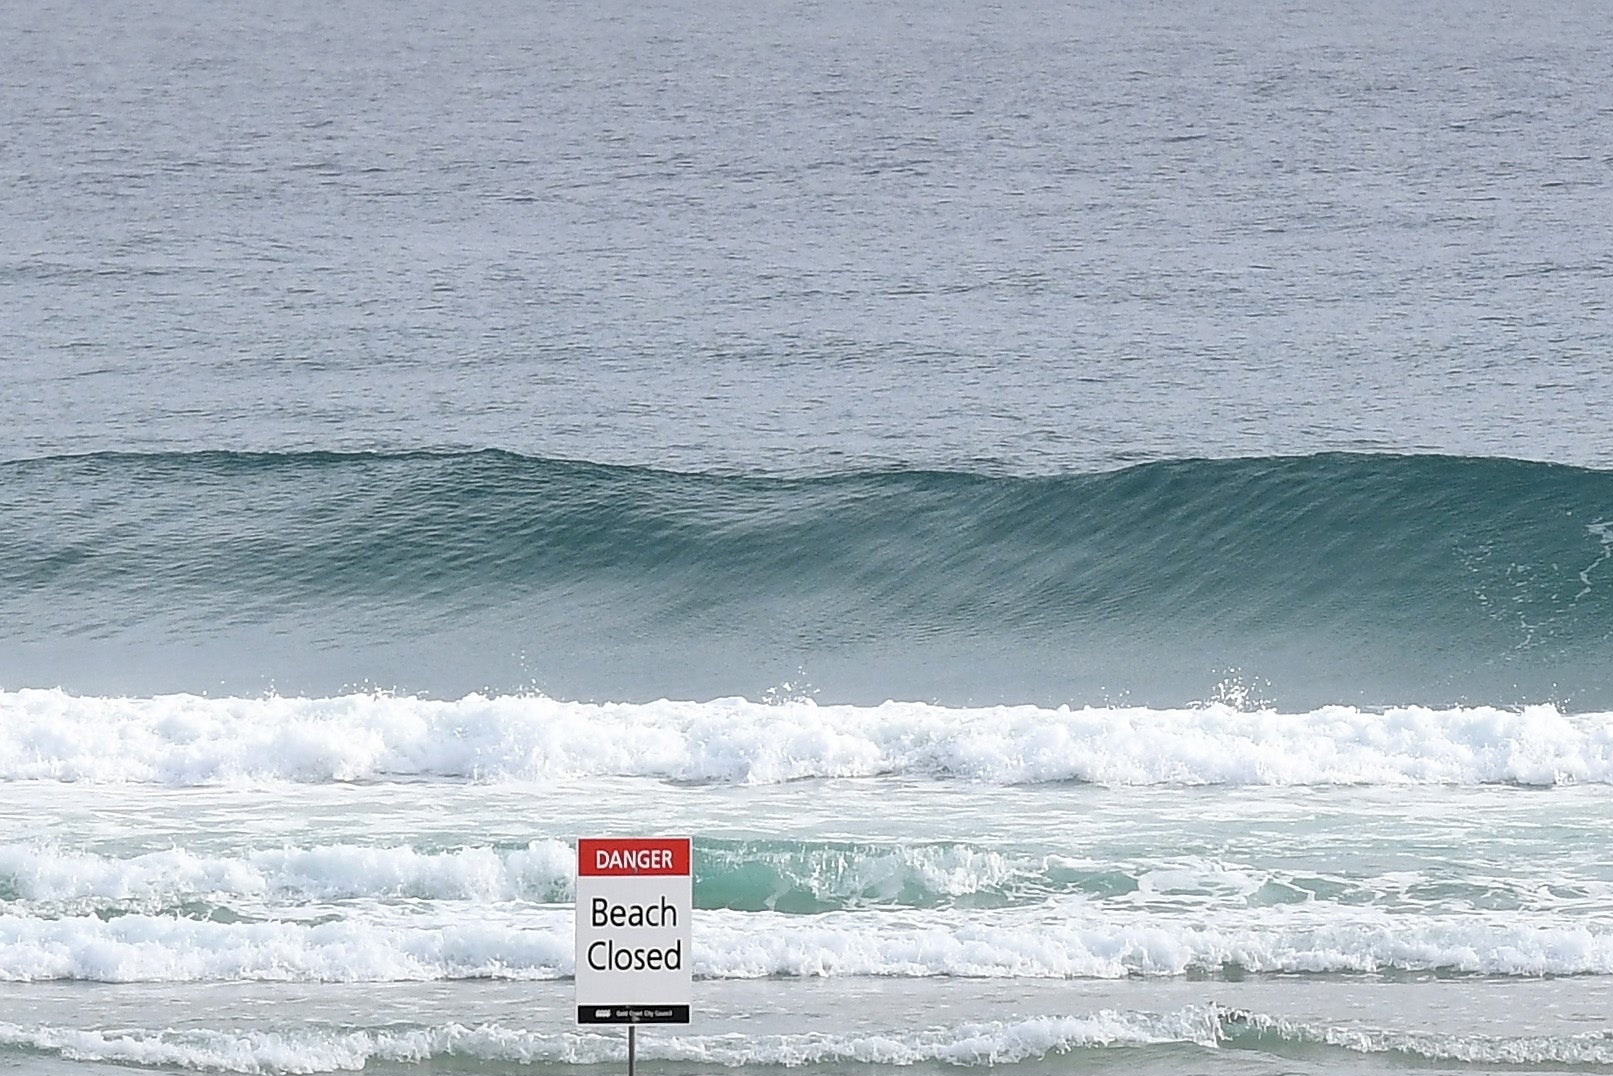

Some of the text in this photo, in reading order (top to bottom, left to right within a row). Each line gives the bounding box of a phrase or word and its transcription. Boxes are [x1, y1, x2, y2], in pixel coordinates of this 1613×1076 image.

[596, 850, 673, 869] DANGER
[592, 896, 677, 927] Beach
[588, 939, 681, 971] Closed
